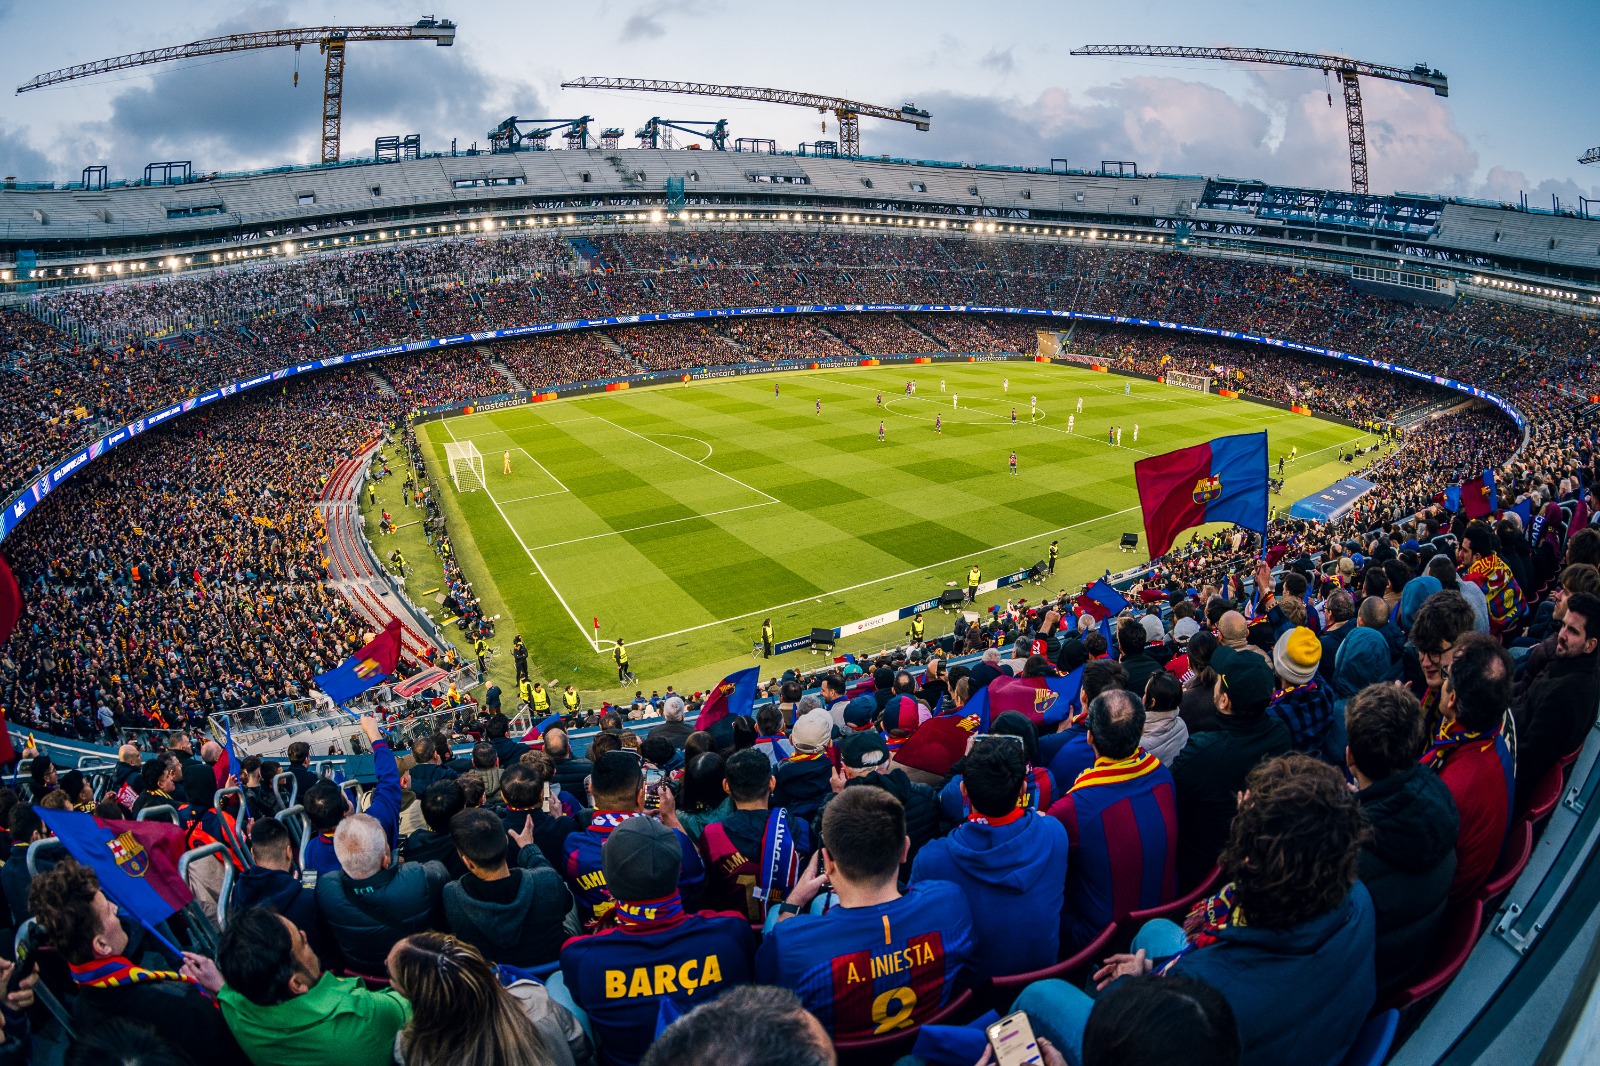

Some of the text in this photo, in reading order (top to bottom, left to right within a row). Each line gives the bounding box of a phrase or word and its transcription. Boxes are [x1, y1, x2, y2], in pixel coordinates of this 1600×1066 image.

[820, 360, 858, 368] mastercard
[692, 370, 735, 380] mastercard
[476, 396, 527, 412] mastercard
[846, 941, 935, 985] A. INIESTA
[605, 954, 722, 998] BARÇA
